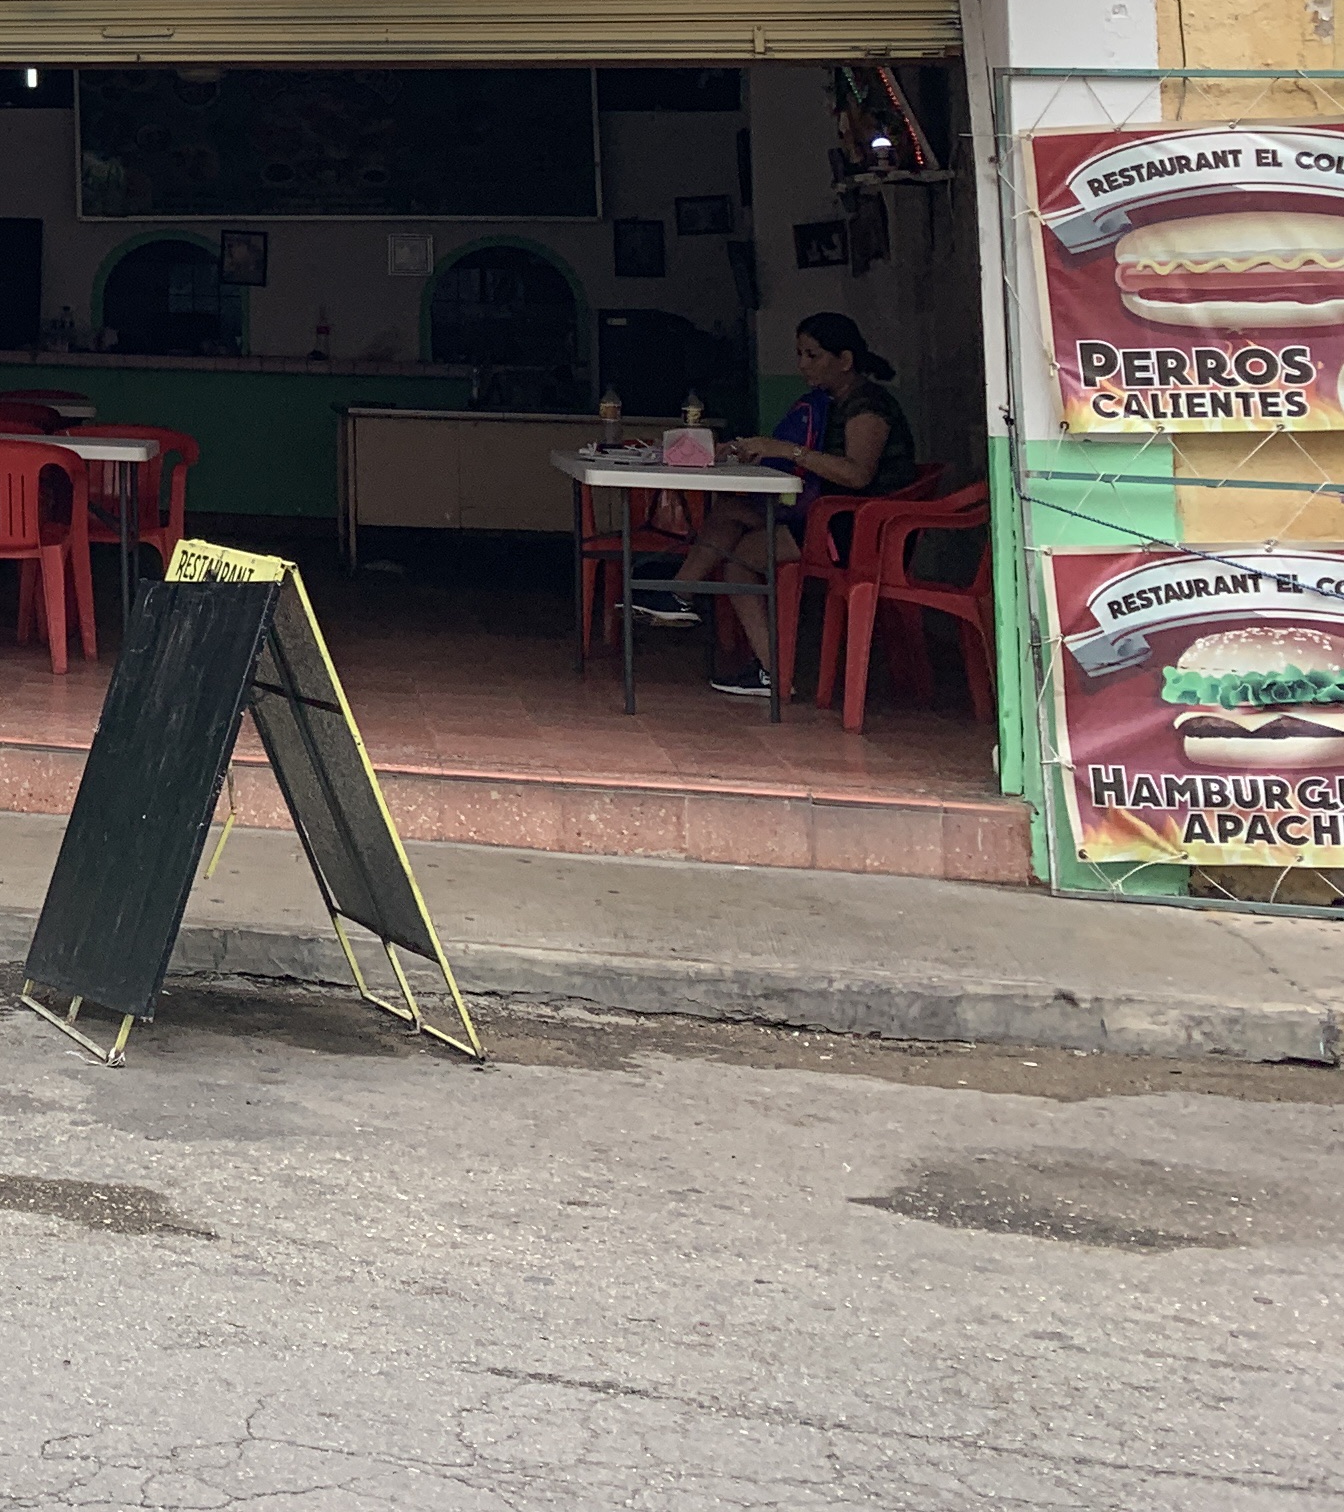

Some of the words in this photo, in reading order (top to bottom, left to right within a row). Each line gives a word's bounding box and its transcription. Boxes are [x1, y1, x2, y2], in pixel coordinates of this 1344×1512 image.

[1087, 148, 1243, 198] RESTAURANT
[1255, 148, 1283, 168] EL
[1076, 340, 1317, 389] PERROS
[1090, 389, 1310, 420] CALIENTES
[1107, 573, 1263, 620] RESTAURANT
[1275, 573, 1303, 594] EL
[1088, 764, 1344, 812] HAMBURG
